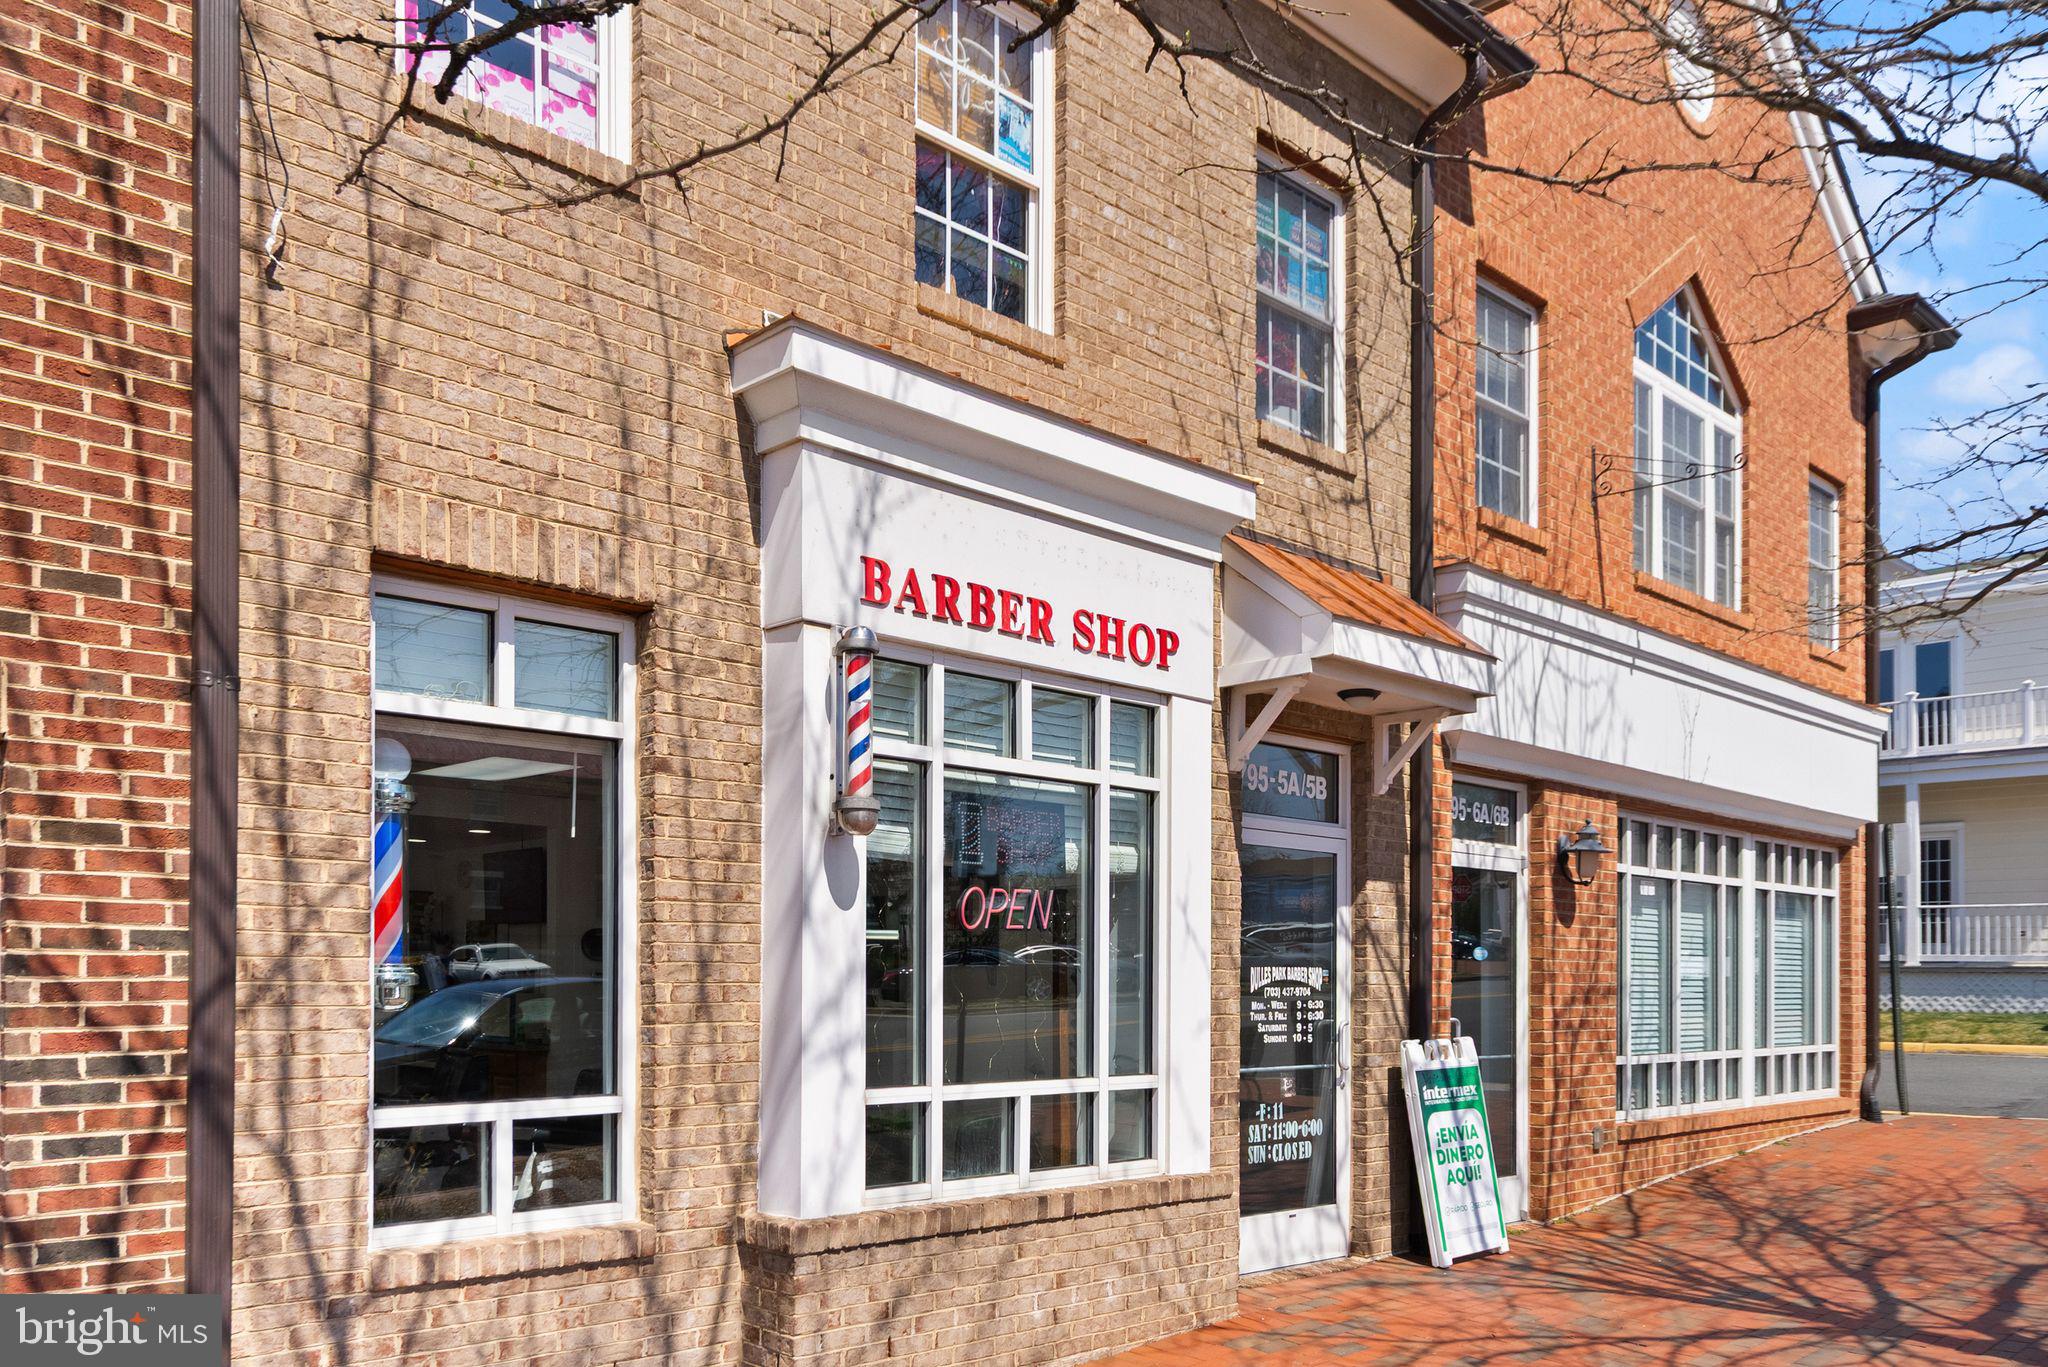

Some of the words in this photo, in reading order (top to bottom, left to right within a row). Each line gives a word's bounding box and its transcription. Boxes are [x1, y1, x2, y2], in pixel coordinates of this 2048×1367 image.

[859, 555, 1056, 647] BARBER
[1072, 608, 1180, 672] SHOP
[961, 885, 1054, 931] OPEN
[1250, 966, 1272, 994] DULLES
[1272, 966, 1287, 982] PARK
[1287, 966, 1308, 983] BARBER
[1308, 966, 1323, 992] SHOP
[1264, 986, 1281, 998] (703)
[1282, 986, 1312, 997] 437-9704
[1296, 1000, 1302, 1009] 9
[1307, 1000, 1324, 1009] 6:30
[1296, 1012, 1302, 1020] 9
[1307, 1011, 1324, 1020] 6:30
[1292, 1034, 1302, 1042] 10
[1307, 1034, 1313, 1043] 5
[1296, 1023, 1302, 1032] 9
[1307, 1023, 1313, 1032] 5
[1422, 1084, 1478, 1101] intermex
[1436, 1120, 1479, 1148] ¡ENVÍA
[1272, 1140, 1313, 1163] CLOSED
[1435, 1144, 1484, 1166] DINERO
[1447, 1160, 1482, 1186] AQUÍ!
